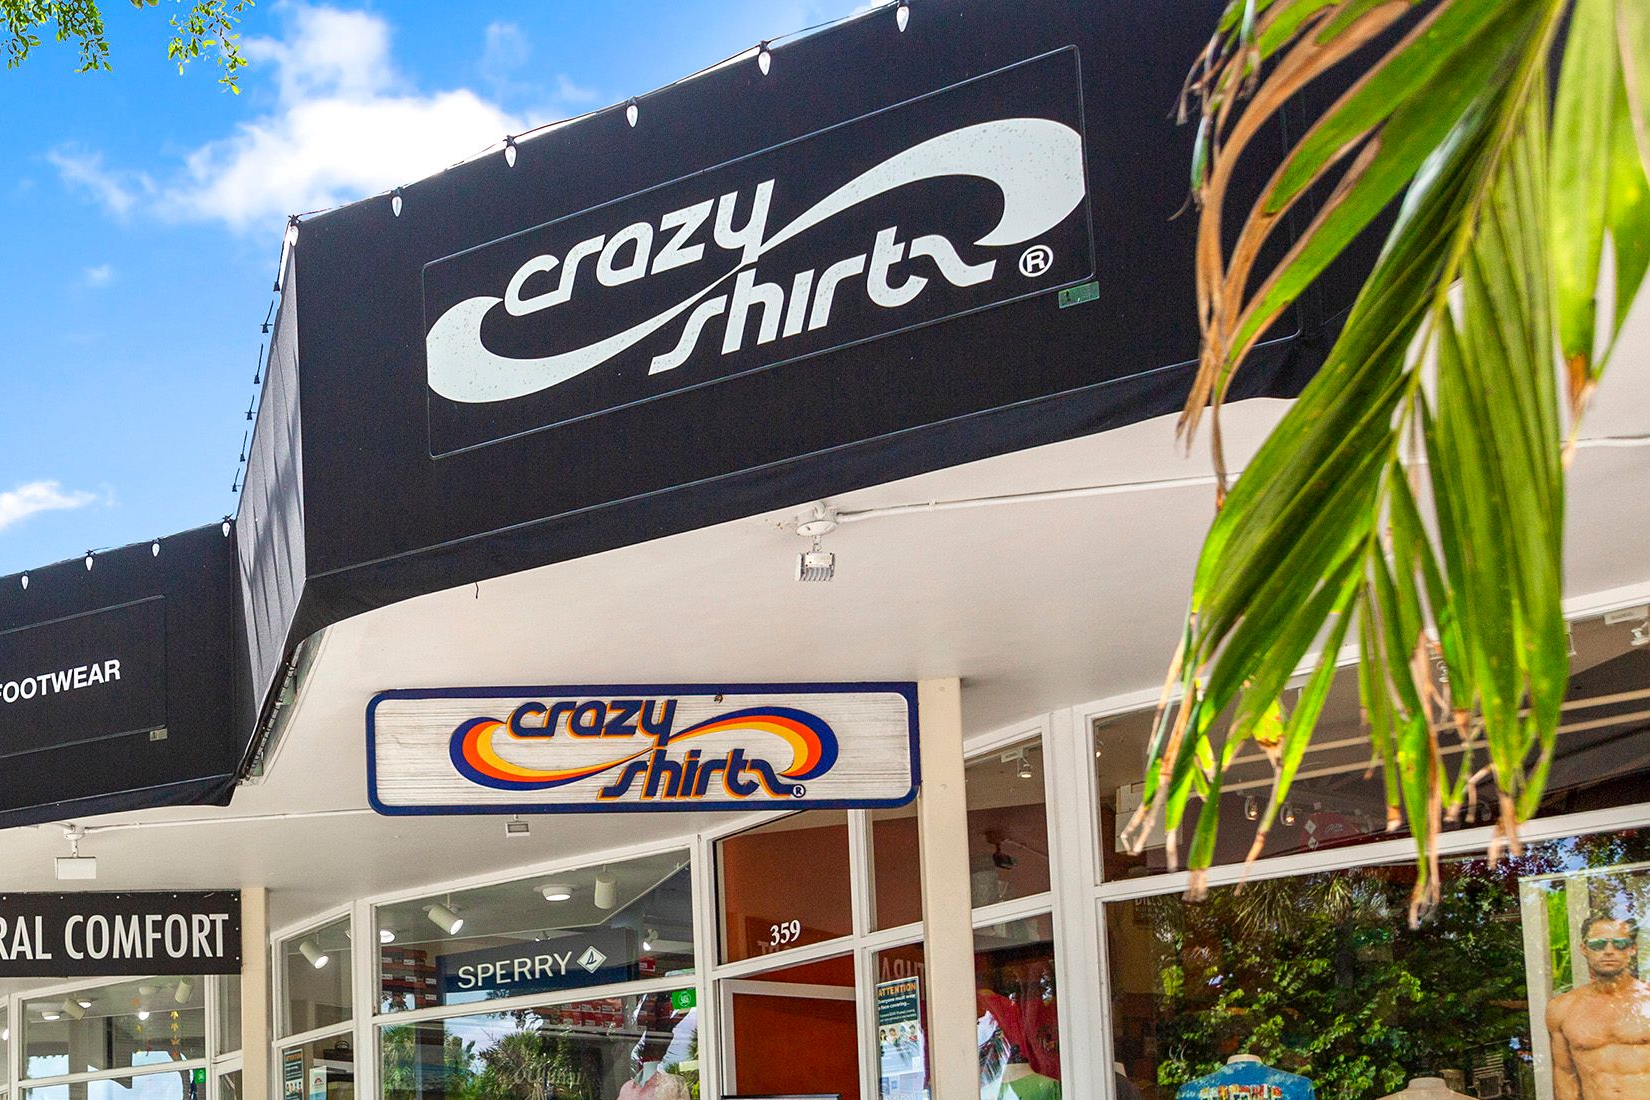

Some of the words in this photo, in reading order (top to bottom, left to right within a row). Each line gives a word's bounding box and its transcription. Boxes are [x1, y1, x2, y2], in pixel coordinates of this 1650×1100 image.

[502, 178, 777, 316] crazy
[506, 699, 678, 746] crazy
[65, 913, 229, 959] COMFORT
[769, 919, 801, 946] 359
[457, 950, 573, 990] SPERRY
[878, 983, 916, 997] ATTENTION
